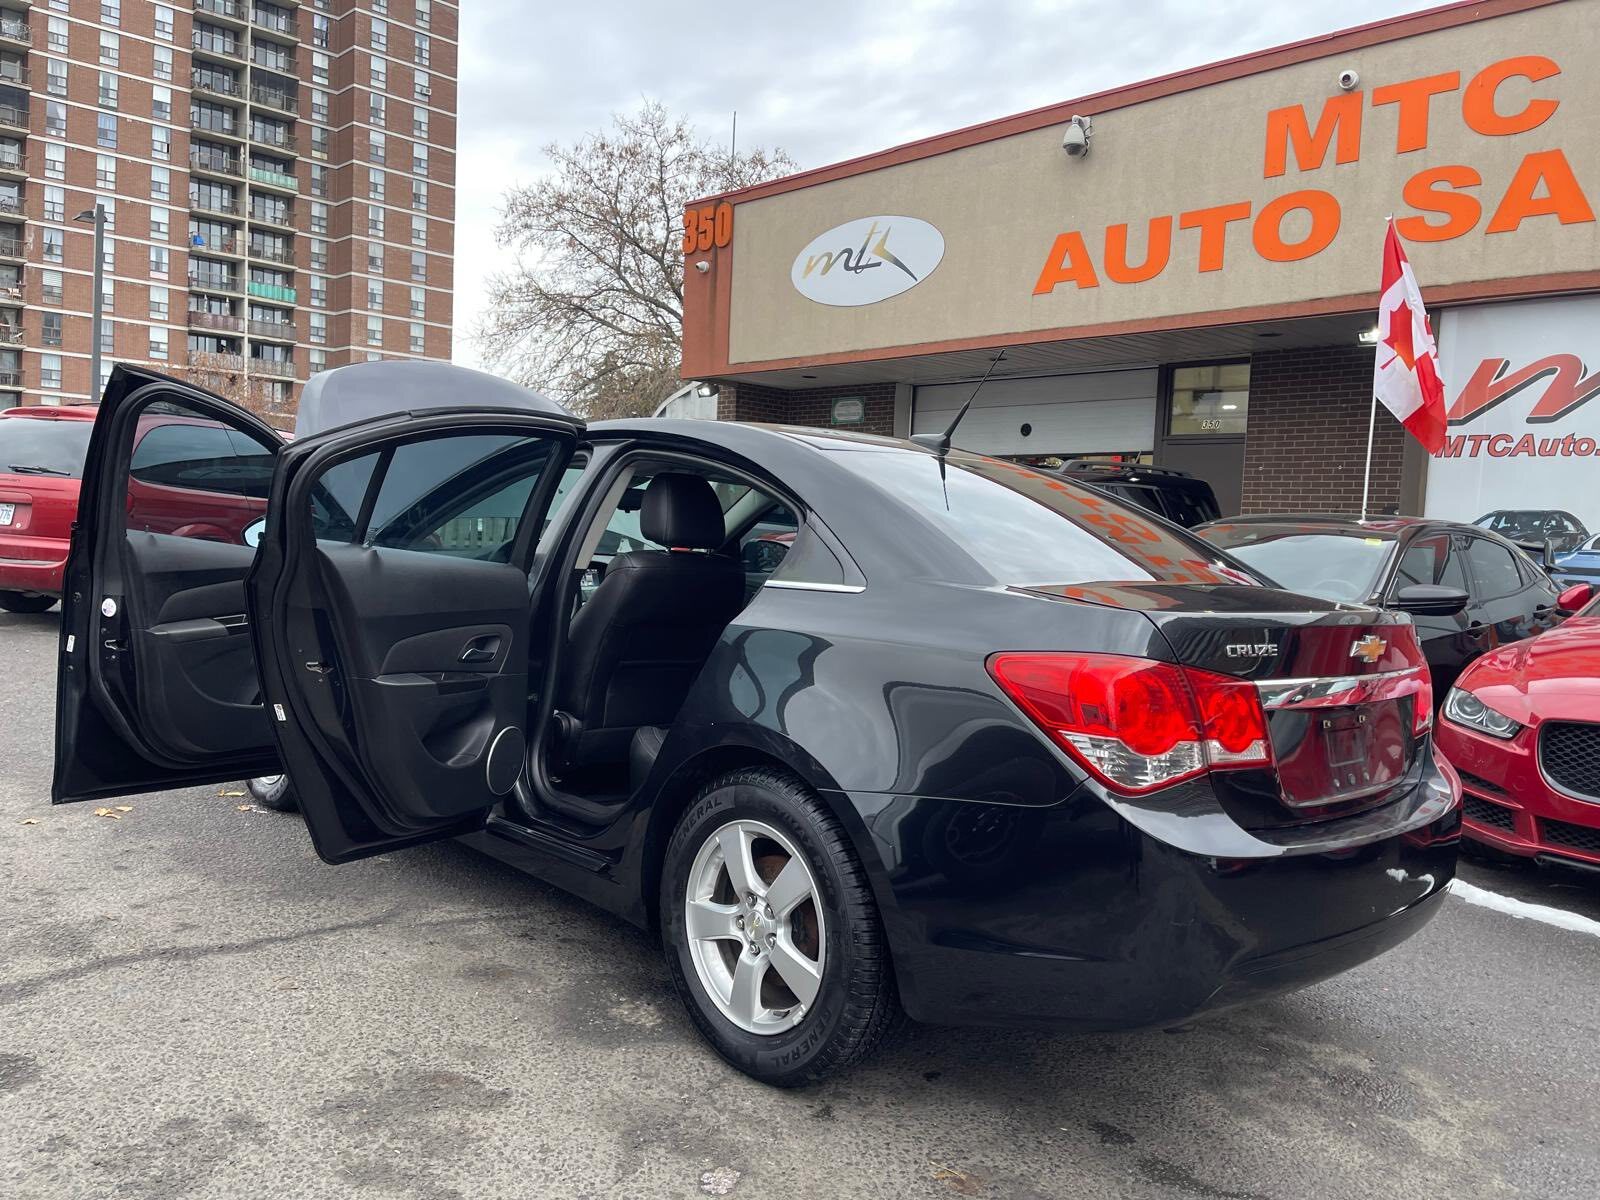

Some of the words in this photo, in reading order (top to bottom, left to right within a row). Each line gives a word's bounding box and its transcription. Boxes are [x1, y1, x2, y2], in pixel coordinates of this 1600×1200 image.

[1265, 57, 1559, 177] MTC
[682, 202, 733, 253] 350
[1033, 190, 1341, 295] AUTO
[1397, 150, 1595, 242] SA
[1201, 420, 1221, 430] 350
[1226, 643, 1278, 657] CRUZE
